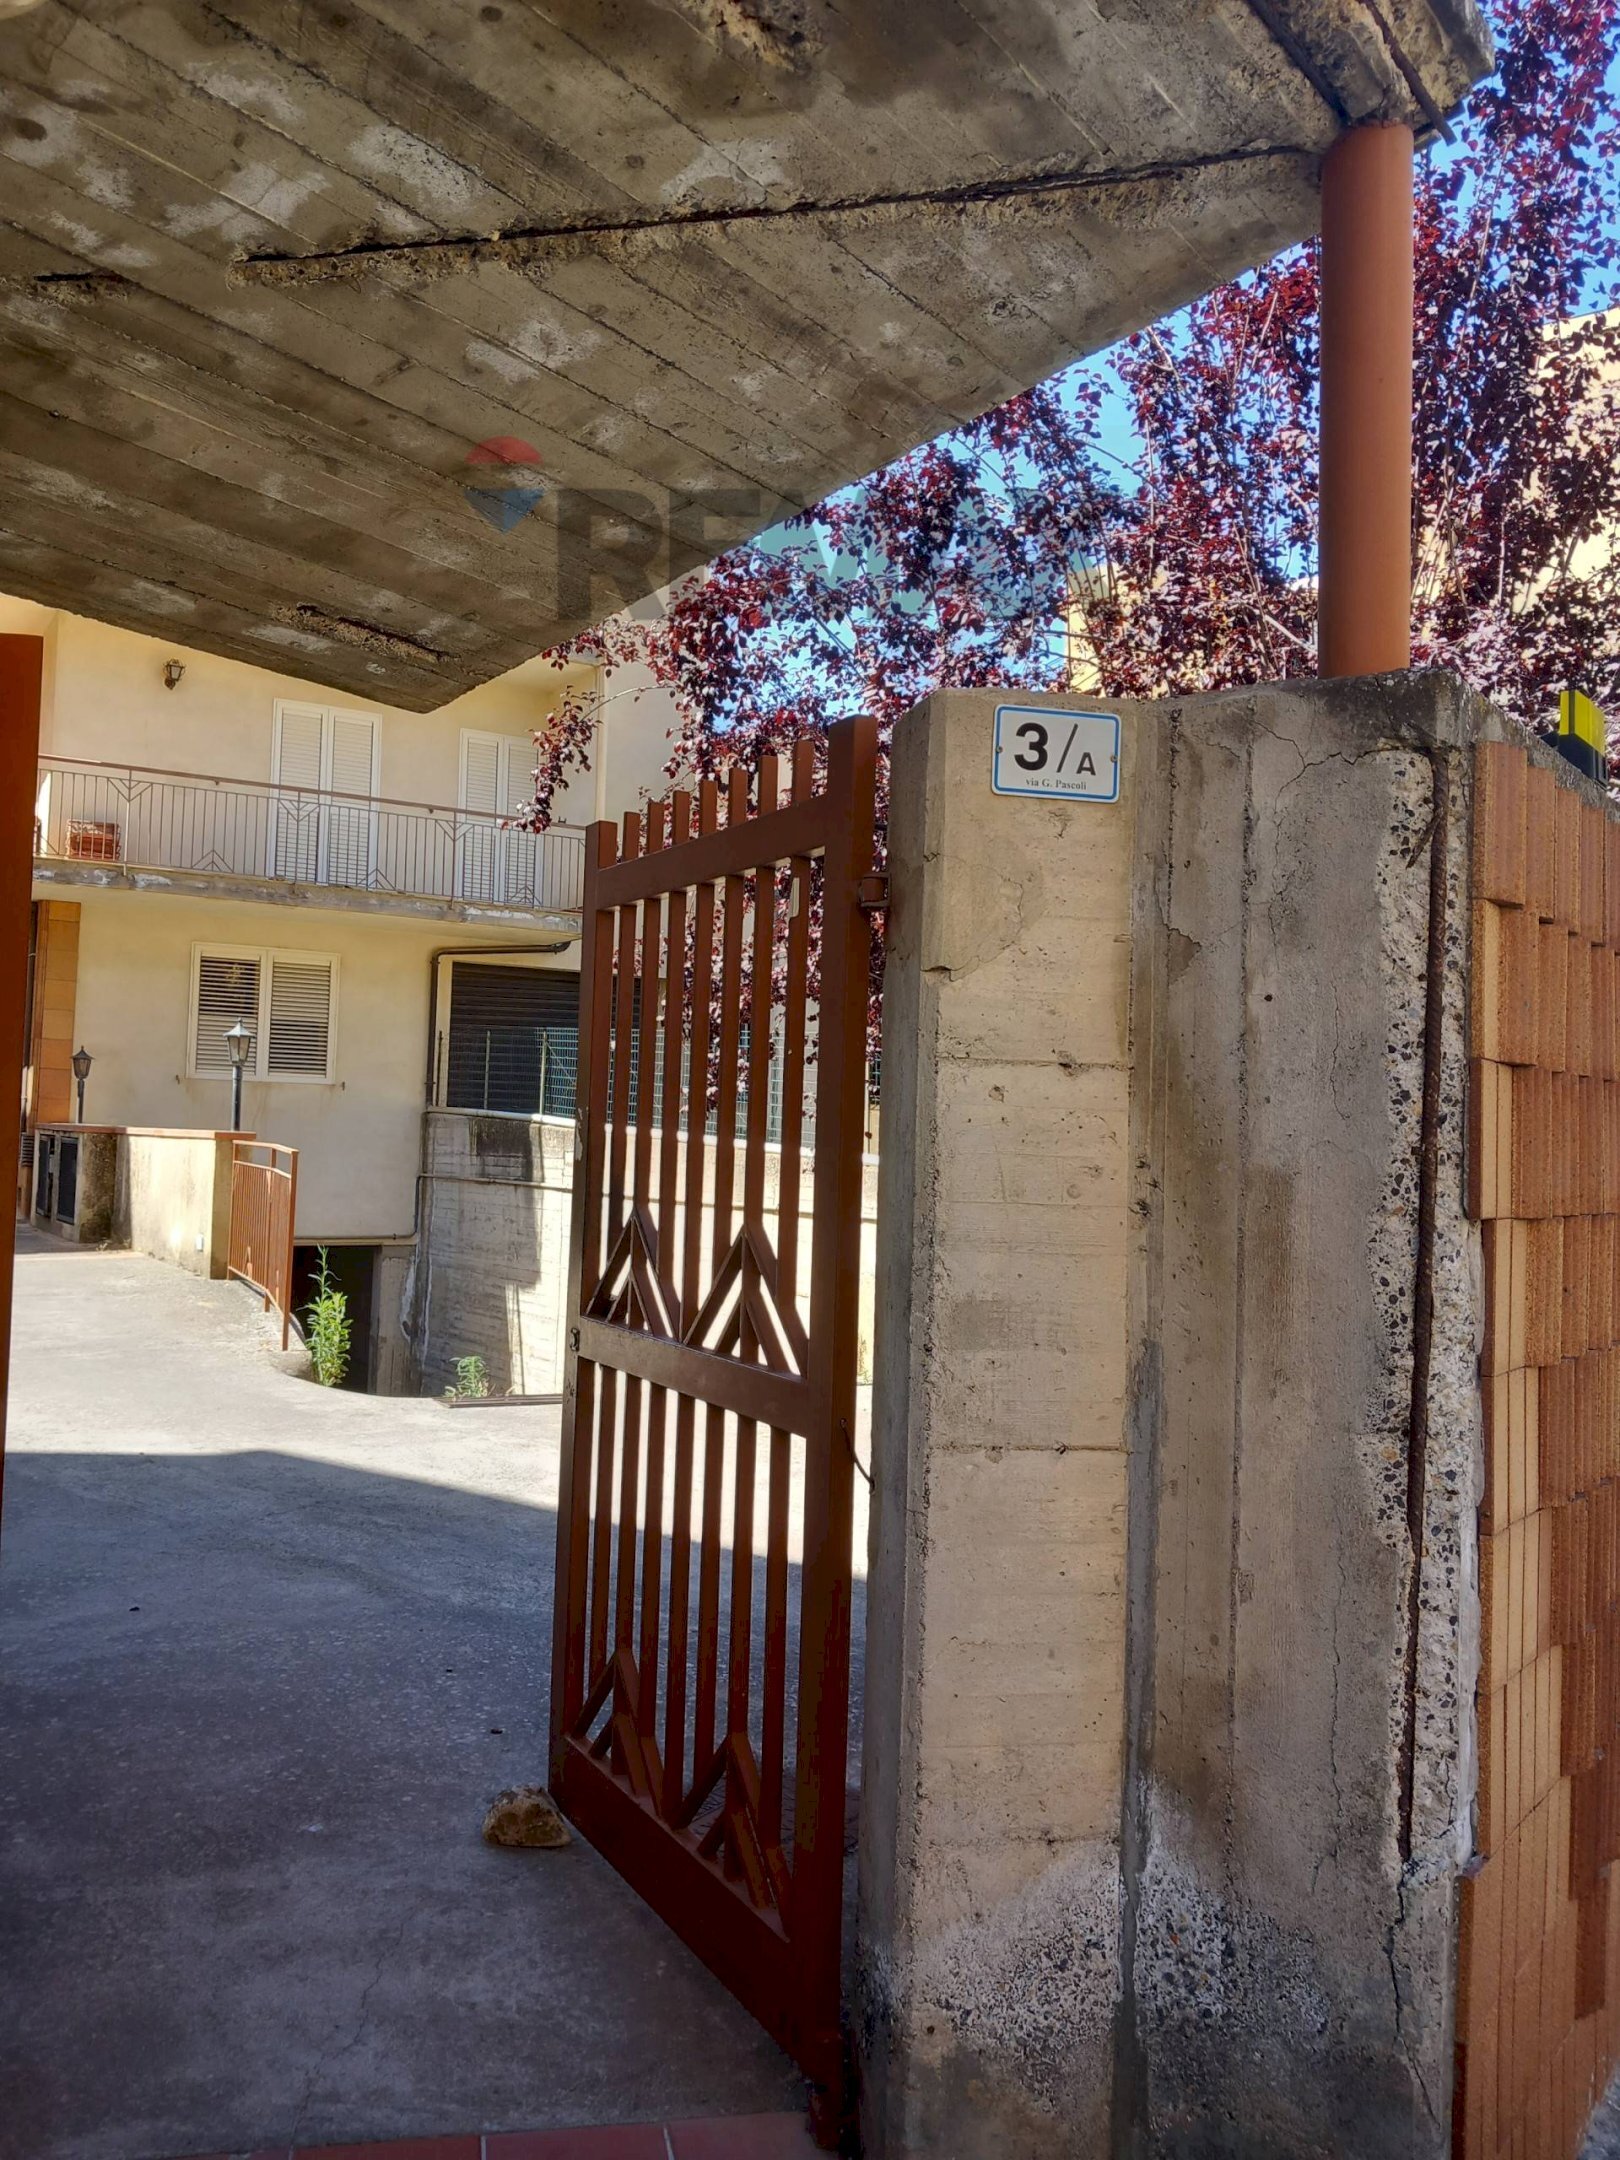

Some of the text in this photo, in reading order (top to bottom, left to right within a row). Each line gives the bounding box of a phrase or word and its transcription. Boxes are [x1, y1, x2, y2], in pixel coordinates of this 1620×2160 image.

[1025, 777, 1087, 791] via G. Pascoli
